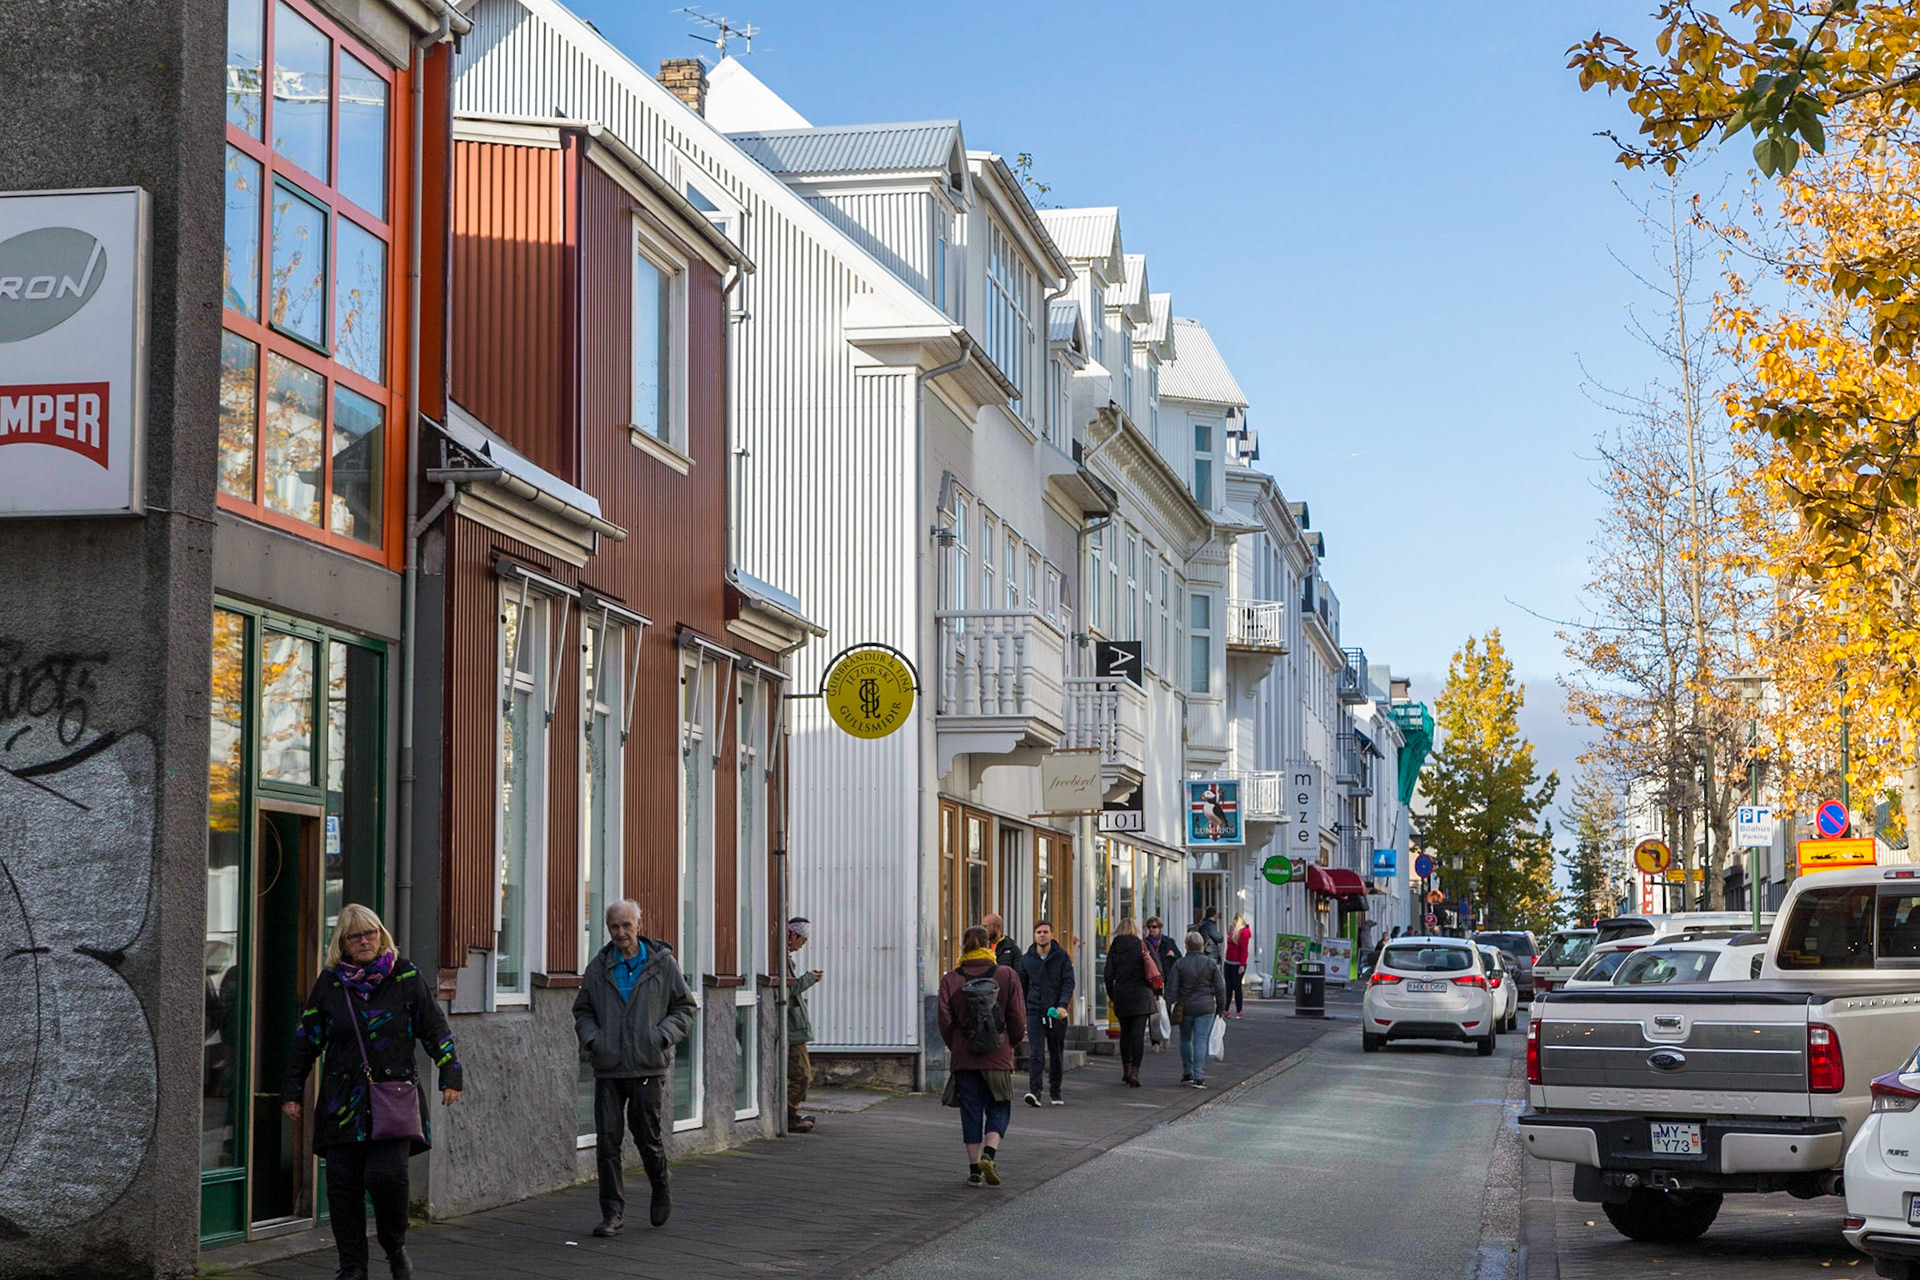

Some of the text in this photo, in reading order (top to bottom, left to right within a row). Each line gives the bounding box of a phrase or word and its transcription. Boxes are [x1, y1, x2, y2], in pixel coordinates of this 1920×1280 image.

[845, 666, 894, 686] JEZORSKI
[887, 659, 896, 668] &
[896, 668, 911, 693] TINA
[1049, 774, 1097, 792] freebird
[1294, 773, 1312, 842] meze
[1103, 814, 1138, 829] 101
[1588, 1090, 1759, 1110] SUPER DUTY
[1662, 1139, 1690, 1152] Y73
